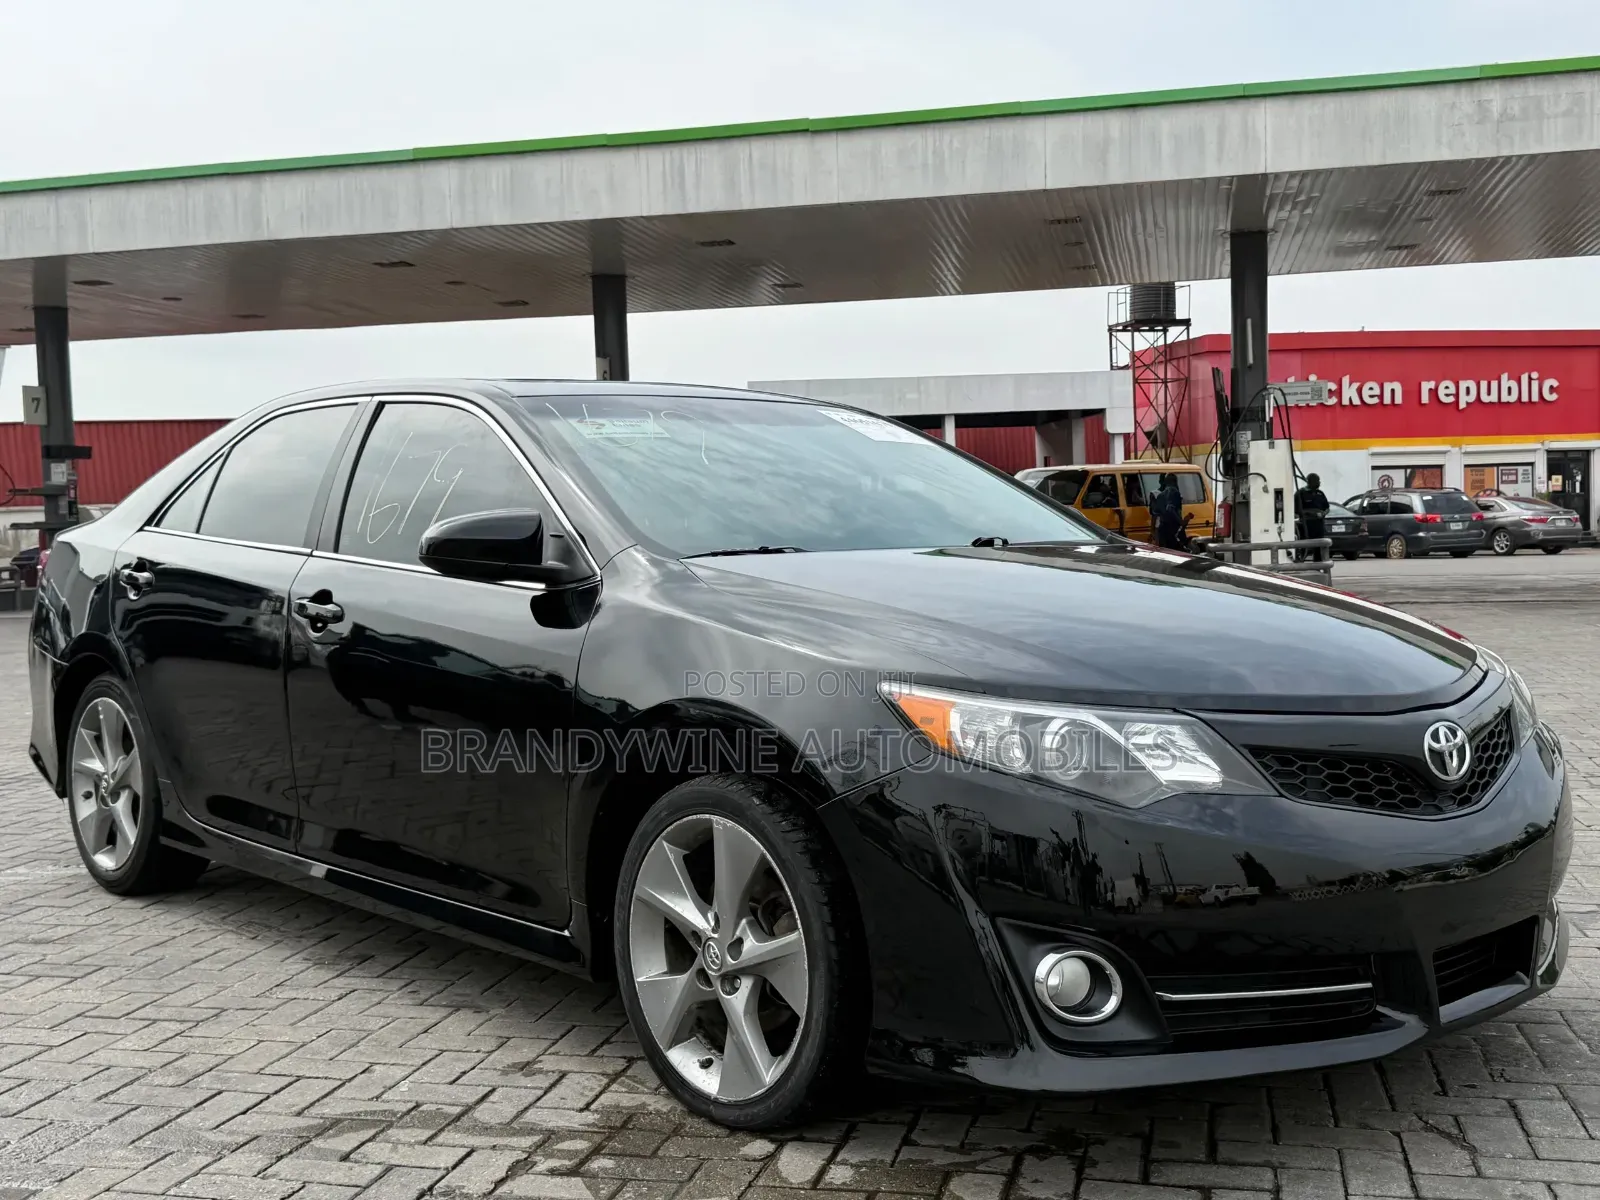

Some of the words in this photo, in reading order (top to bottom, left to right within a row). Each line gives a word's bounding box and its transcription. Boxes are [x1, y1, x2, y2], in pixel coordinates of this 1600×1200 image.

[1286, 373, 1403, 406] cken
[1420, 371, 1560, 410] republic
[31, 397, 41, 414] 7
